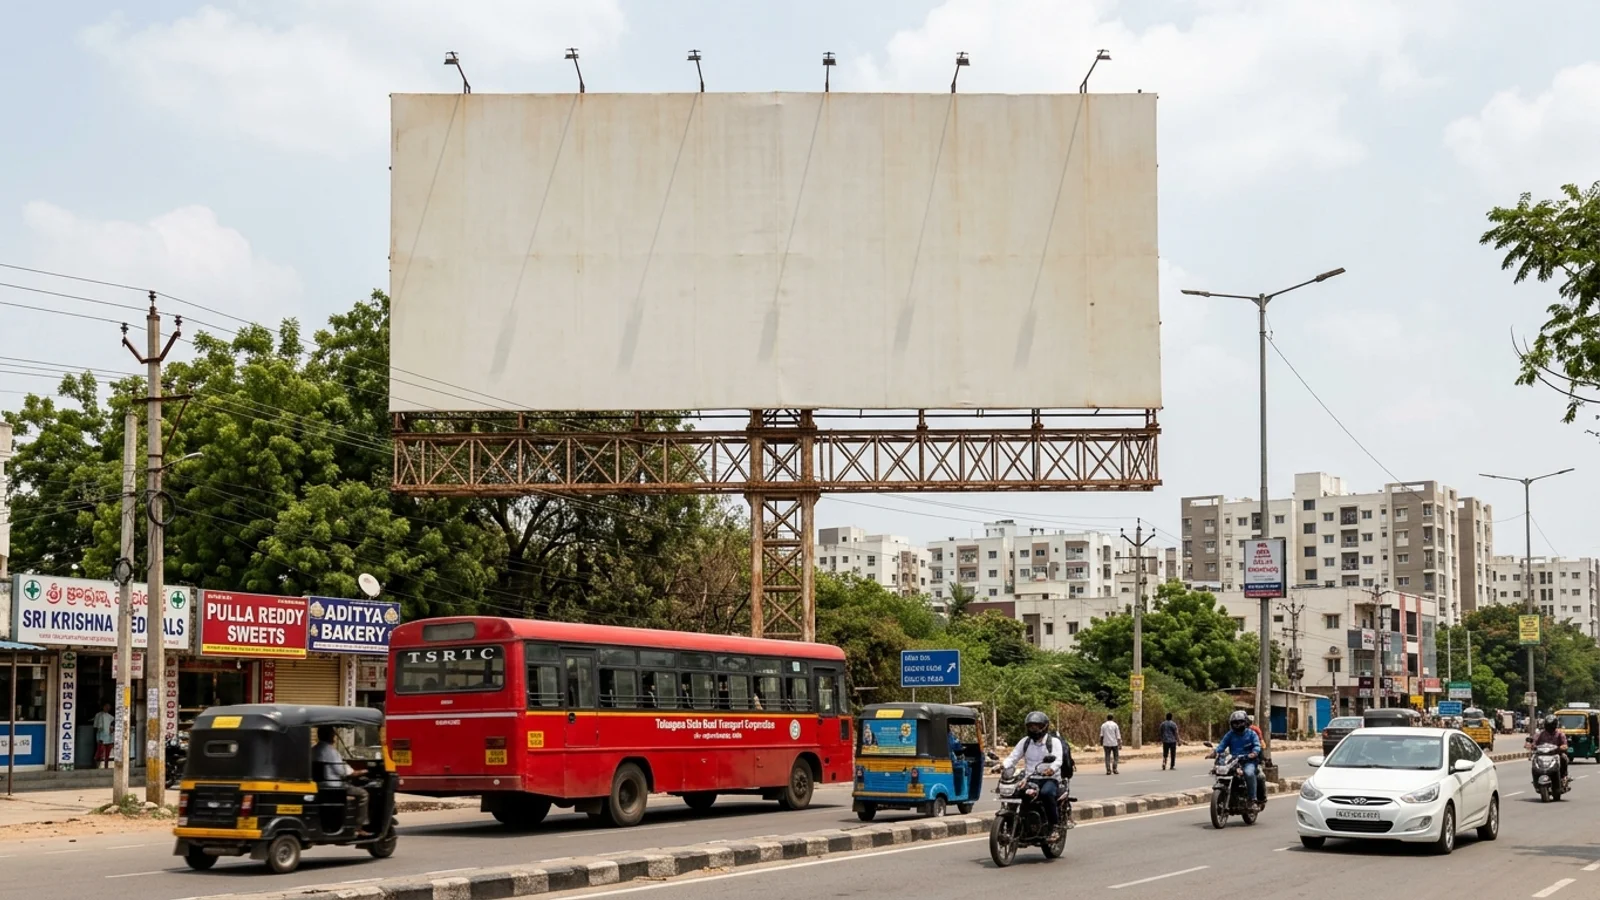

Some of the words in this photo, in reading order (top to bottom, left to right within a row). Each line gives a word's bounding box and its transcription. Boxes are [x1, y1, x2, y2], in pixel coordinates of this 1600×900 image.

[23, 609, 46, 629] SRI
[52, 611, 113, 632] KRISHNA
[207, 602, 254, 623] PULLA
[258, 606, 304, 625] REDDY
[324, 604, 383, 624] ADITYA
[227, 625, 285, 645] SWEETS
[321, 623, 386, 642] BAKERY
